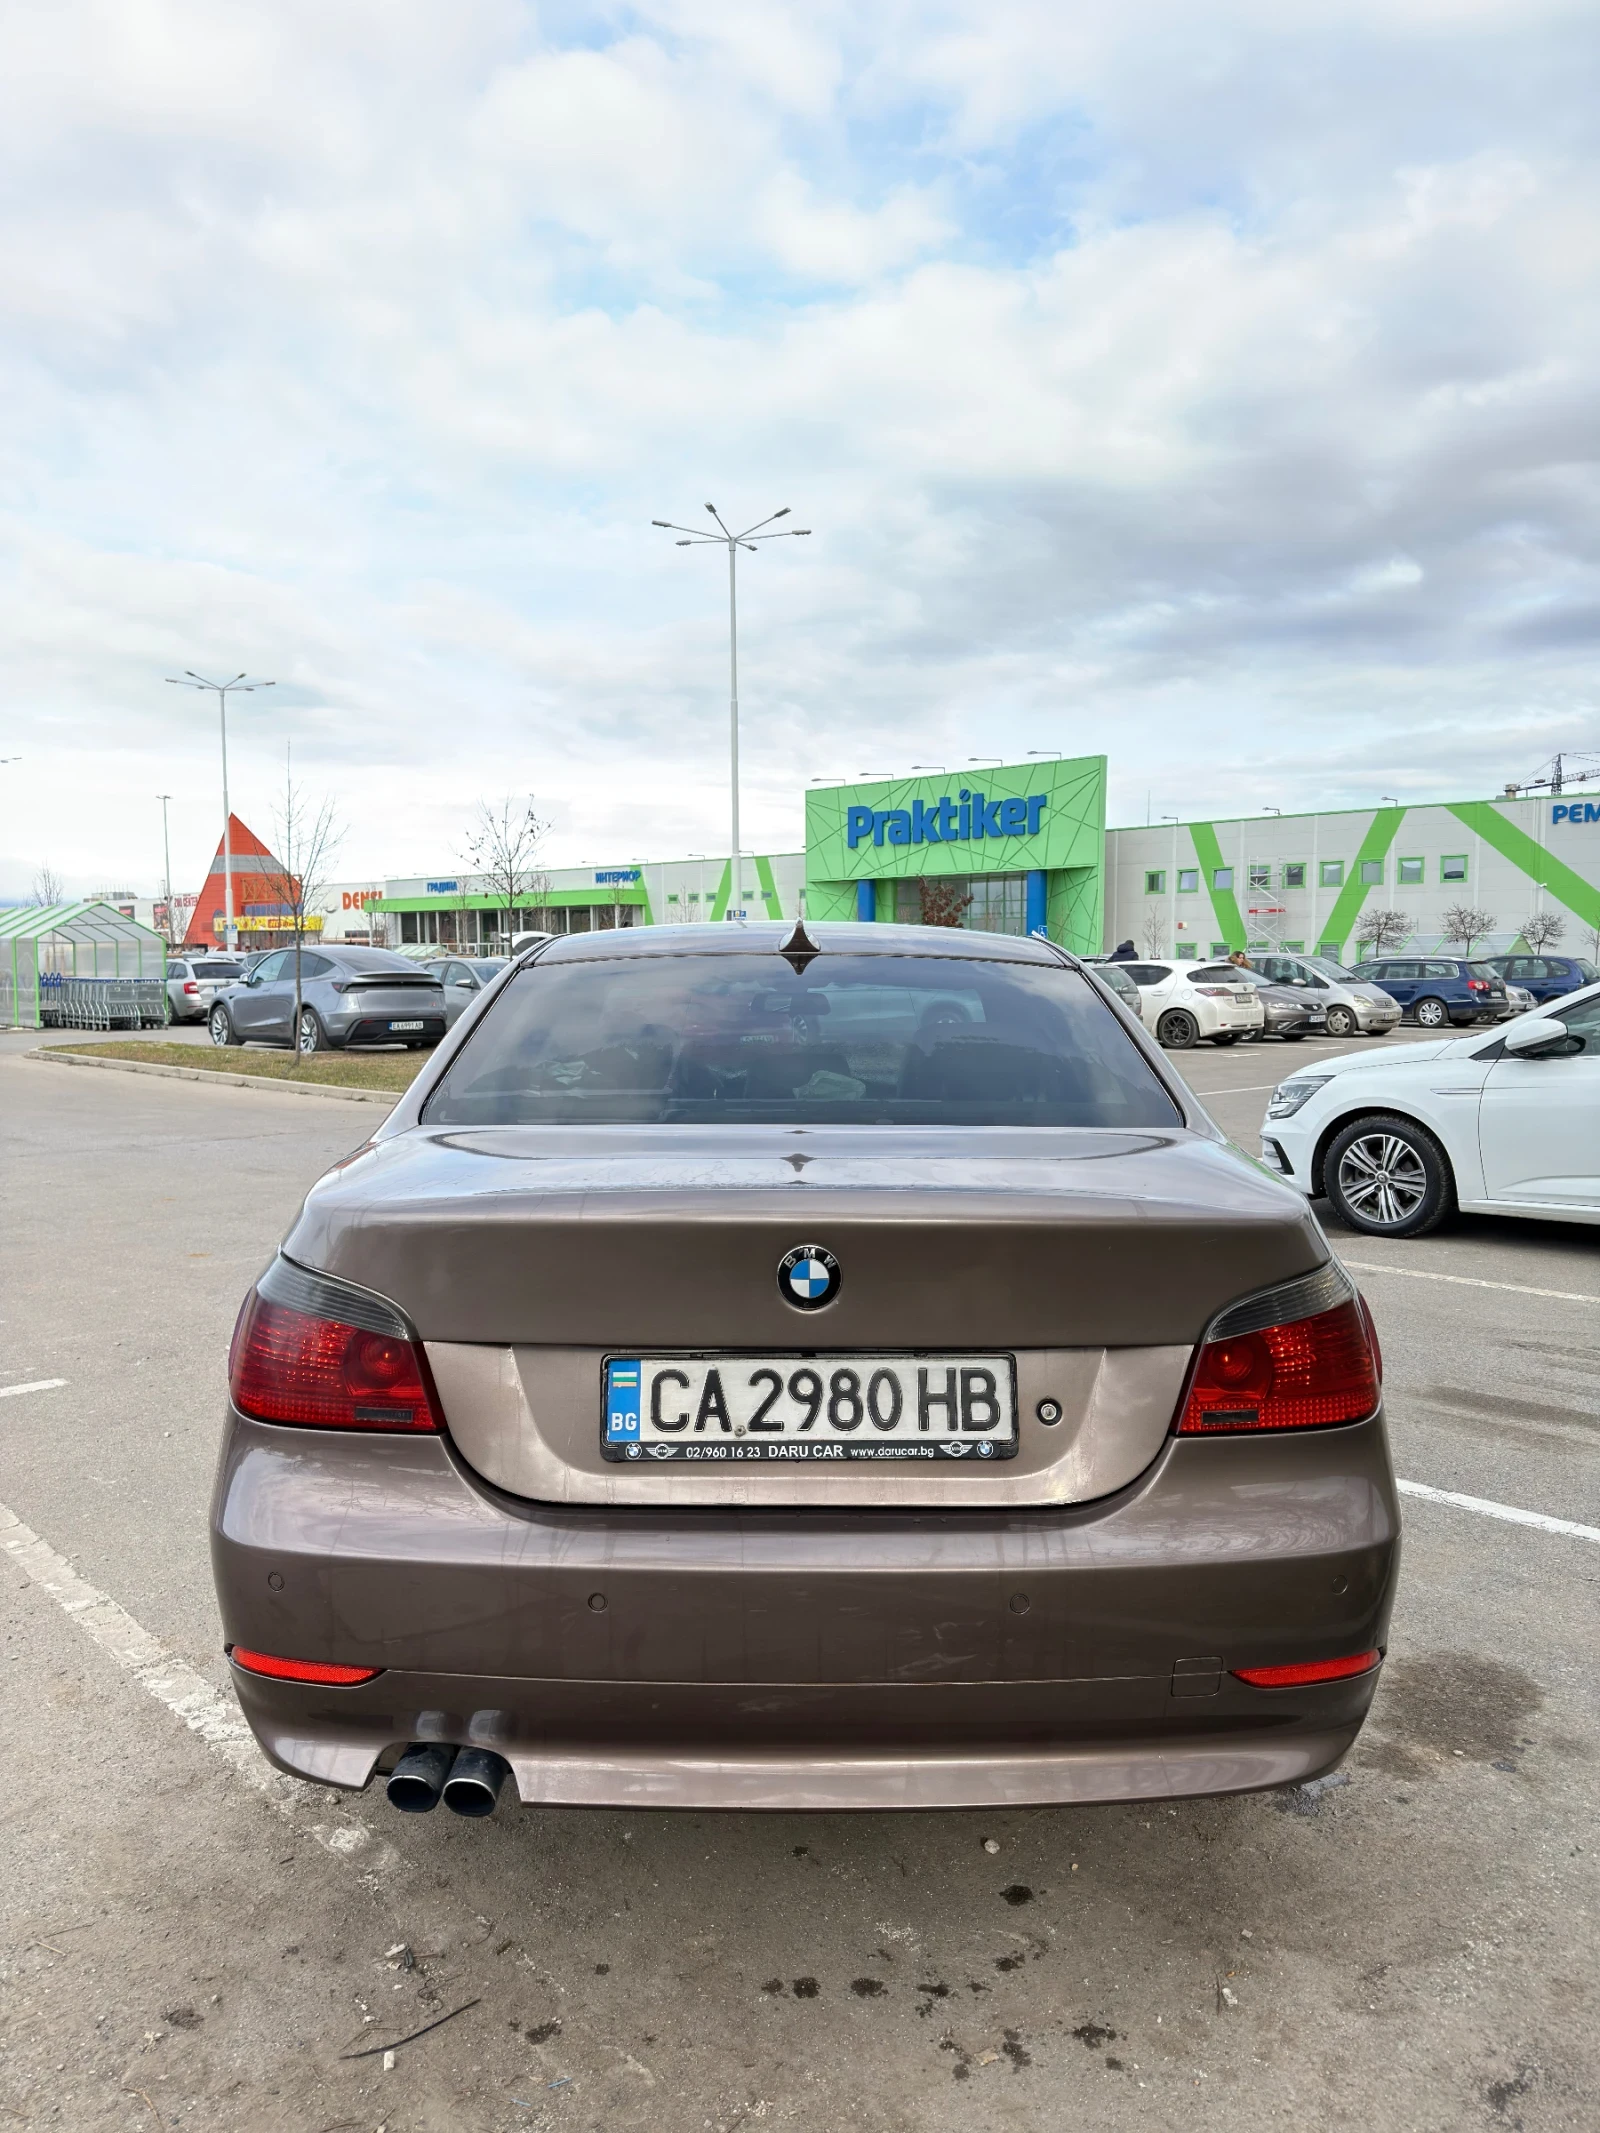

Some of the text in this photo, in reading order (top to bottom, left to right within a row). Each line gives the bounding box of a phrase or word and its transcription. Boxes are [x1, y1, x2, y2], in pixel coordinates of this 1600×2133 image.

[847, 788, 1047, 848] Praktiker
[1552, 803, 1600, 825] РЕМ
[595, 870, 641, 884] ИНТЕРИОР
[426, 881, 458, 894] ГРАДИНА
[783, 1248, 837, 1269] BMW
[651, 1366, 1001, 1432] CA 2980 HB
[611, 1412, 637, 1431] BG
[686, 1446, 761, 1459] 02/960 16 23
[768, 1444, 844, 1458] DARU CAR
[850, 1445, 934, 1458] www.darucar.bg
